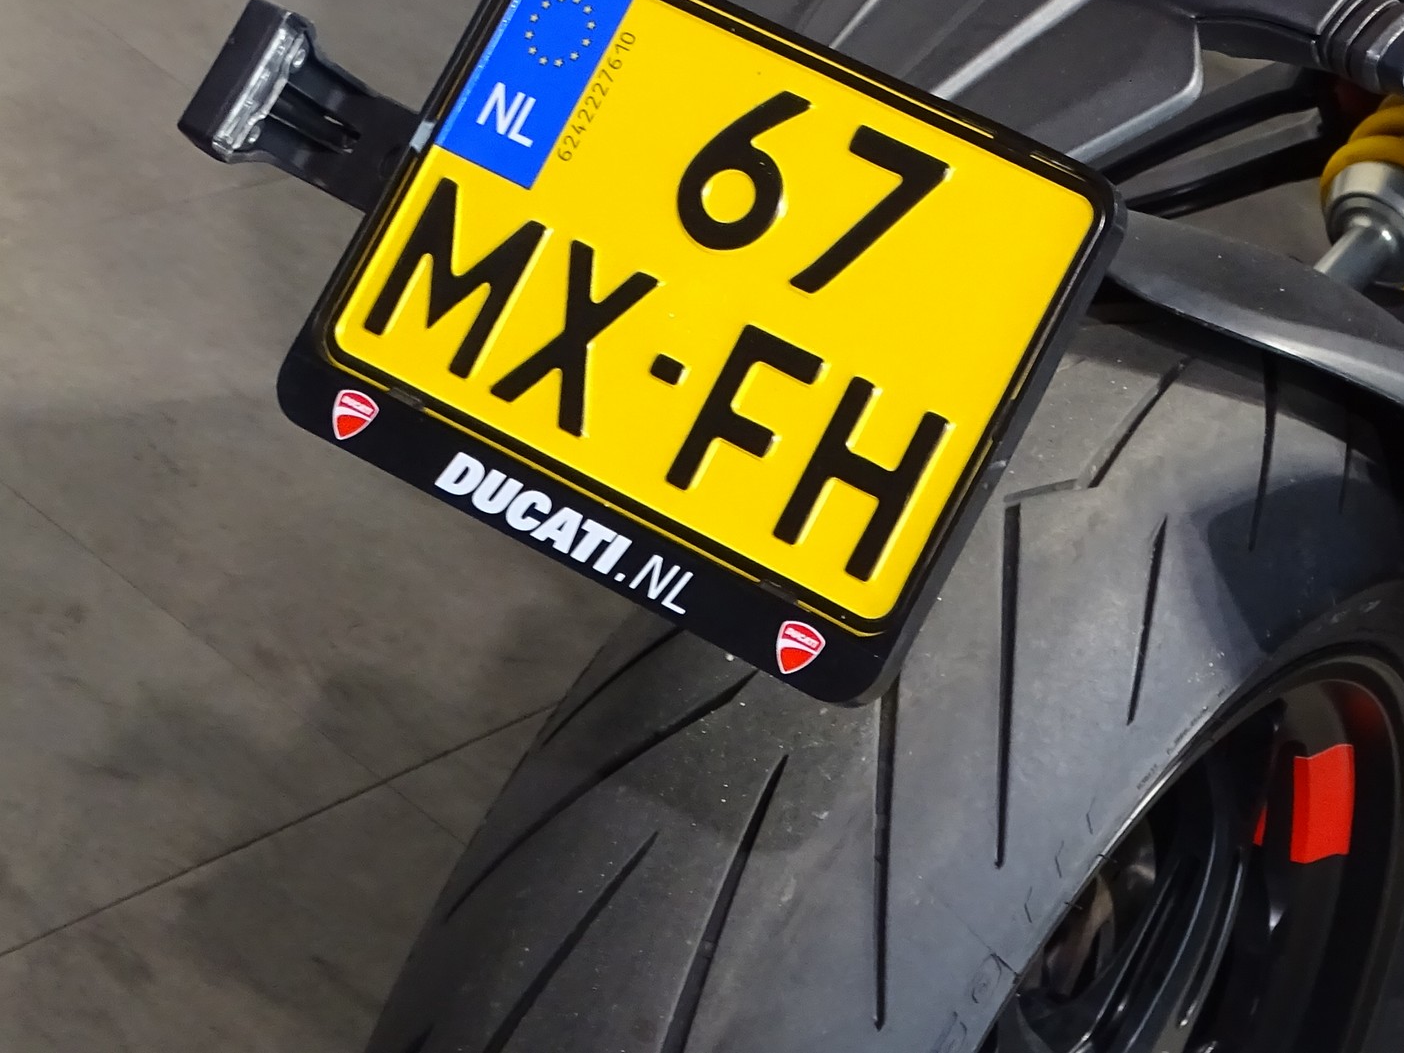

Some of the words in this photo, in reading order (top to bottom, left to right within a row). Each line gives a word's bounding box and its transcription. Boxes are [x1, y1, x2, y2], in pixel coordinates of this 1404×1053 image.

[476, 81, 537, 148] NL
[557, 31, 637, 162] 6242227610
[677, 90, 951, 294] 67
[364, 177, 951, 582] MX-FH
